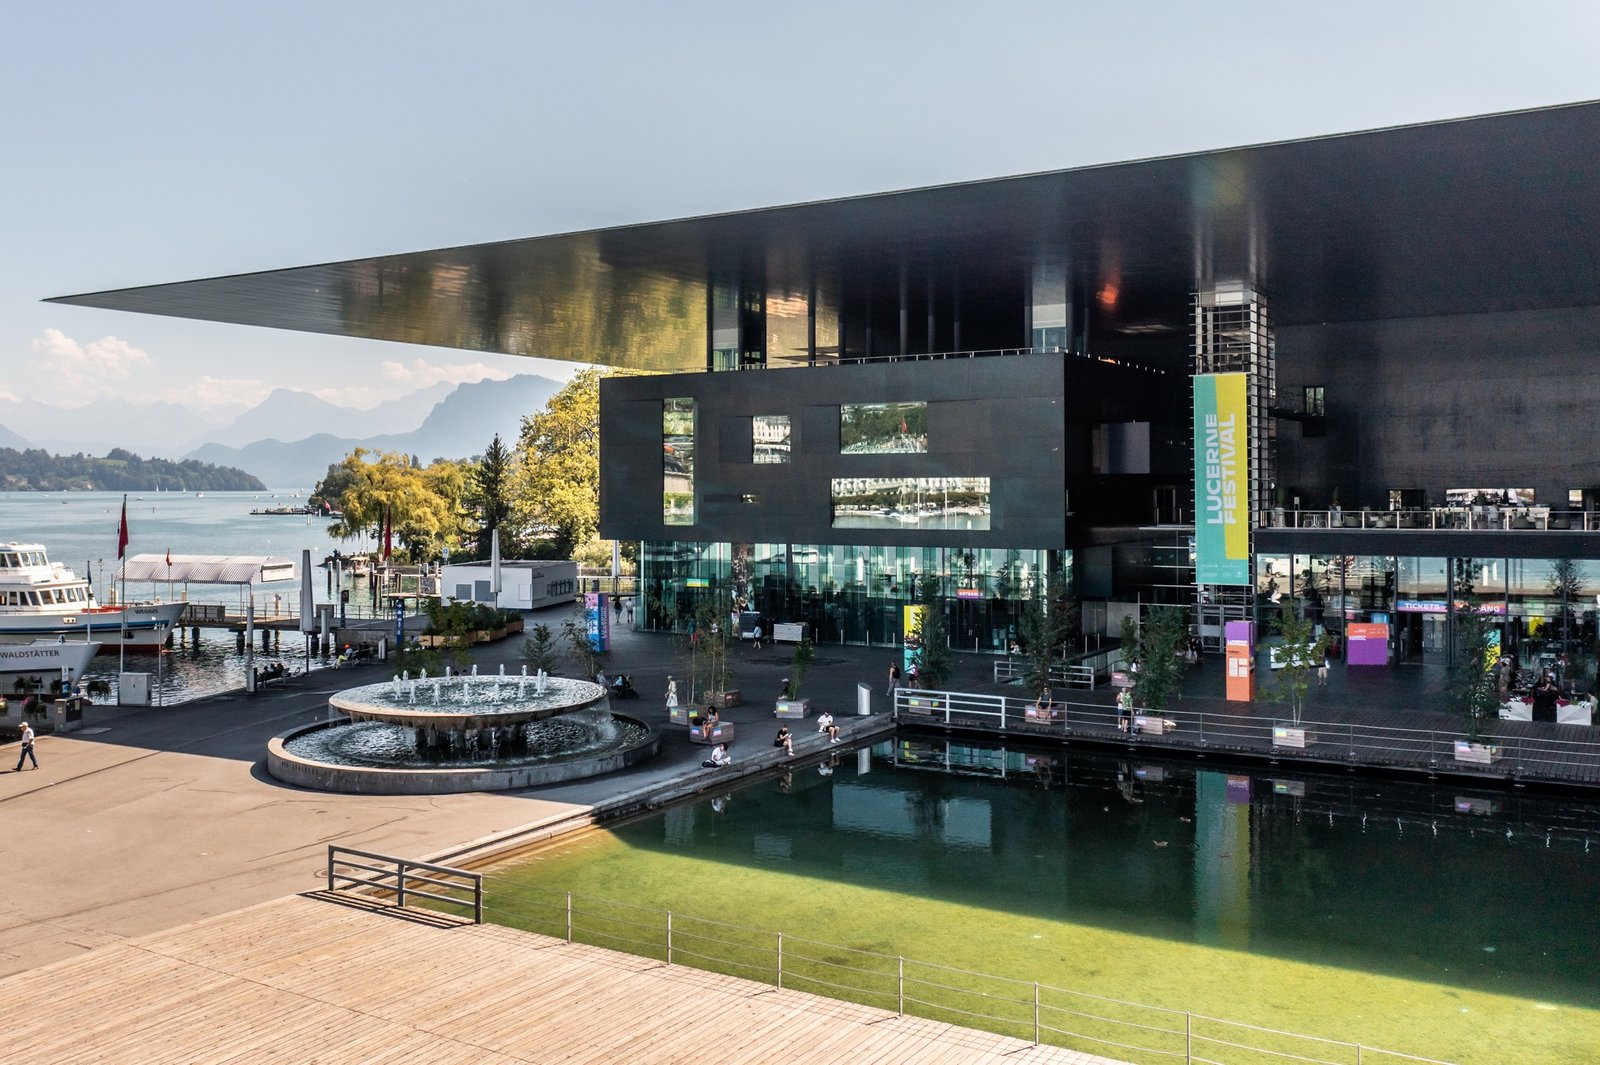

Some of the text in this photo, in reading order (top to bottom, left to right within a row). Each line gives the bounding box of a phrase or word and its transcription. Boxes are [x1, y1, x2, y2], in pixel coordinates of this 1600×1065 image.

[1206, 414, 1223, 524] LUCERNE
[1219, 413, 1237, 525] FESTIVAL
[1404, 602, 1440, 610] TICKETS
[0, 649, 60, 659] WALDSTÄTTER
